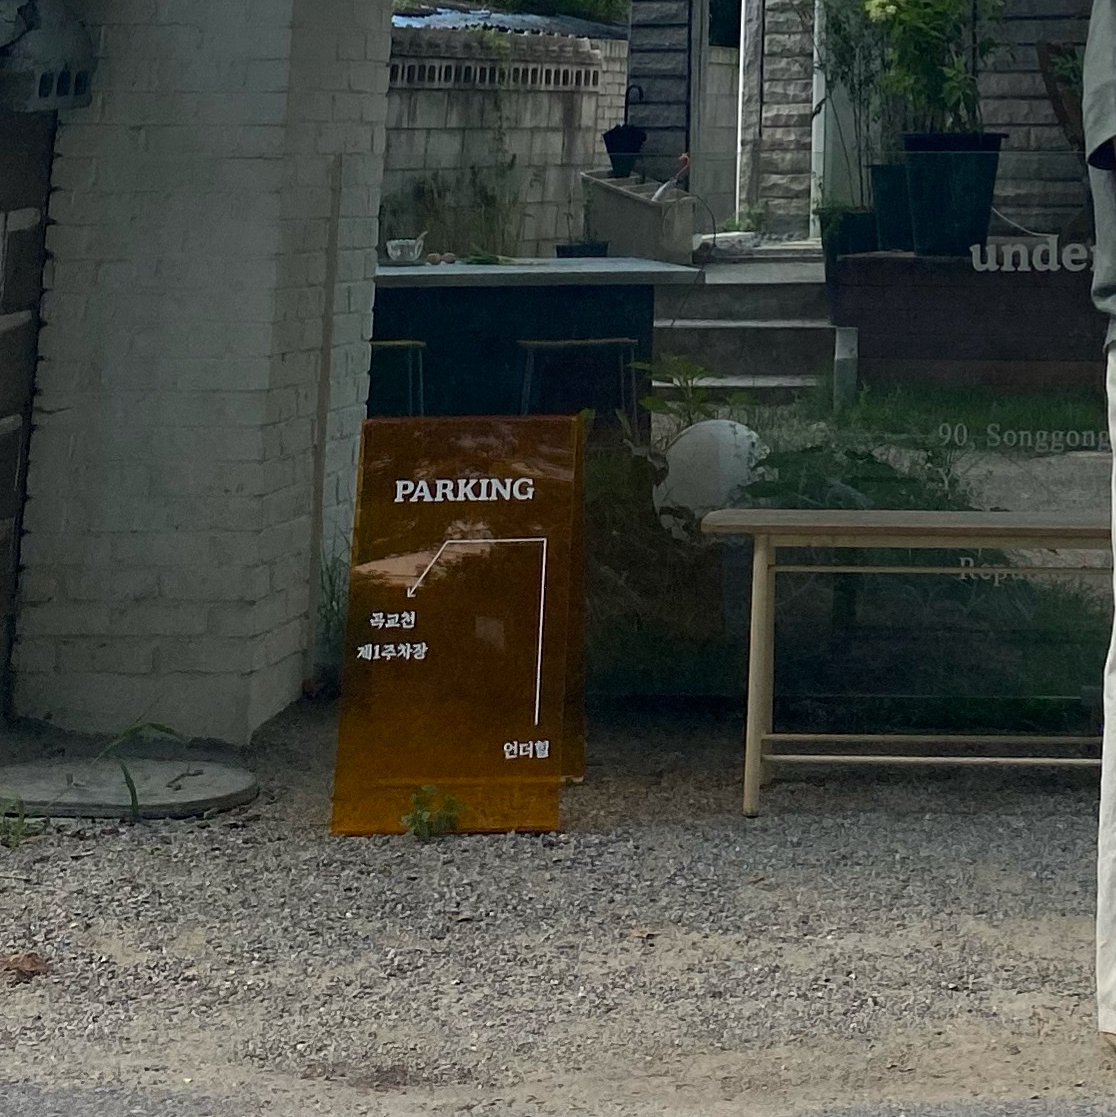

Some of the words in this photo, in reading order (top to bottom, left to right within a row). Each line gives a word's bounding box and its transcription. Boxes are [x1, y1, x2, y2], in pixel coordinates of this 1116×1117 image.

[938, 423, 976, 451] 90,
[393, 477, 534, 503] PARKING
[369, 610, 416, 630] 곡교천
[356, 641, 429, 661] 제1주차장
[503, 739, 550, 760] 언더힐
